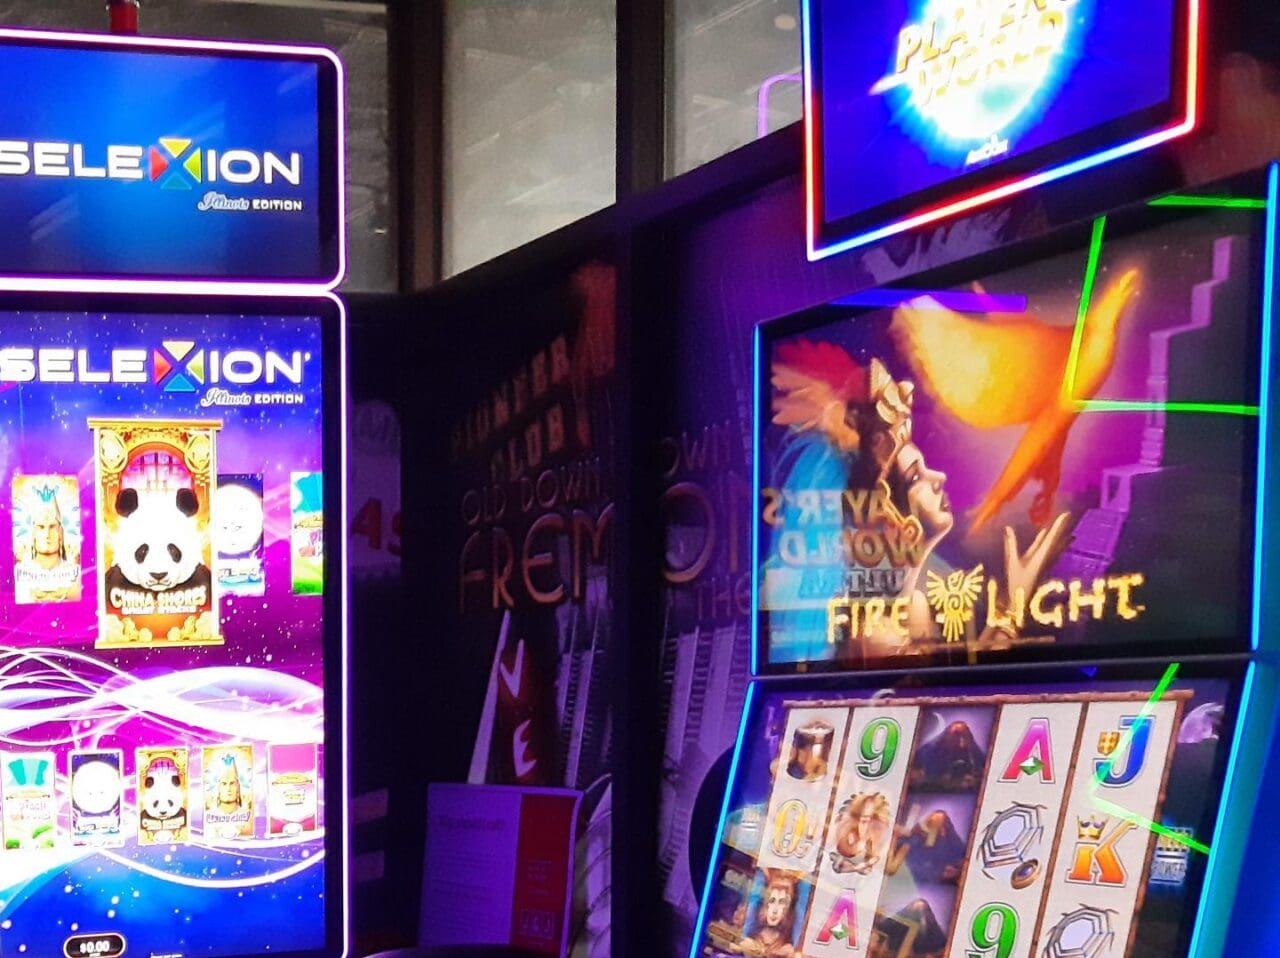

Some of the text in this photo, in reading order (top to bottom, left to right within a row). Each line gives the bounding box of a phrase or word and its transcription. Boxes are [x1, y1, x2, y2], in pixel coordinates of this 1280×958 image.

[198, 192, 303, 211] Illinois EDITION
[201, 387, 304, 406] Illinois EDITION
[827, 572, 1146, 644] FIRE LIGHT
[856, 716, 901, 781] 9
[998, 717, 1056, 785] A
[1065, 820, 1138, 888] K
